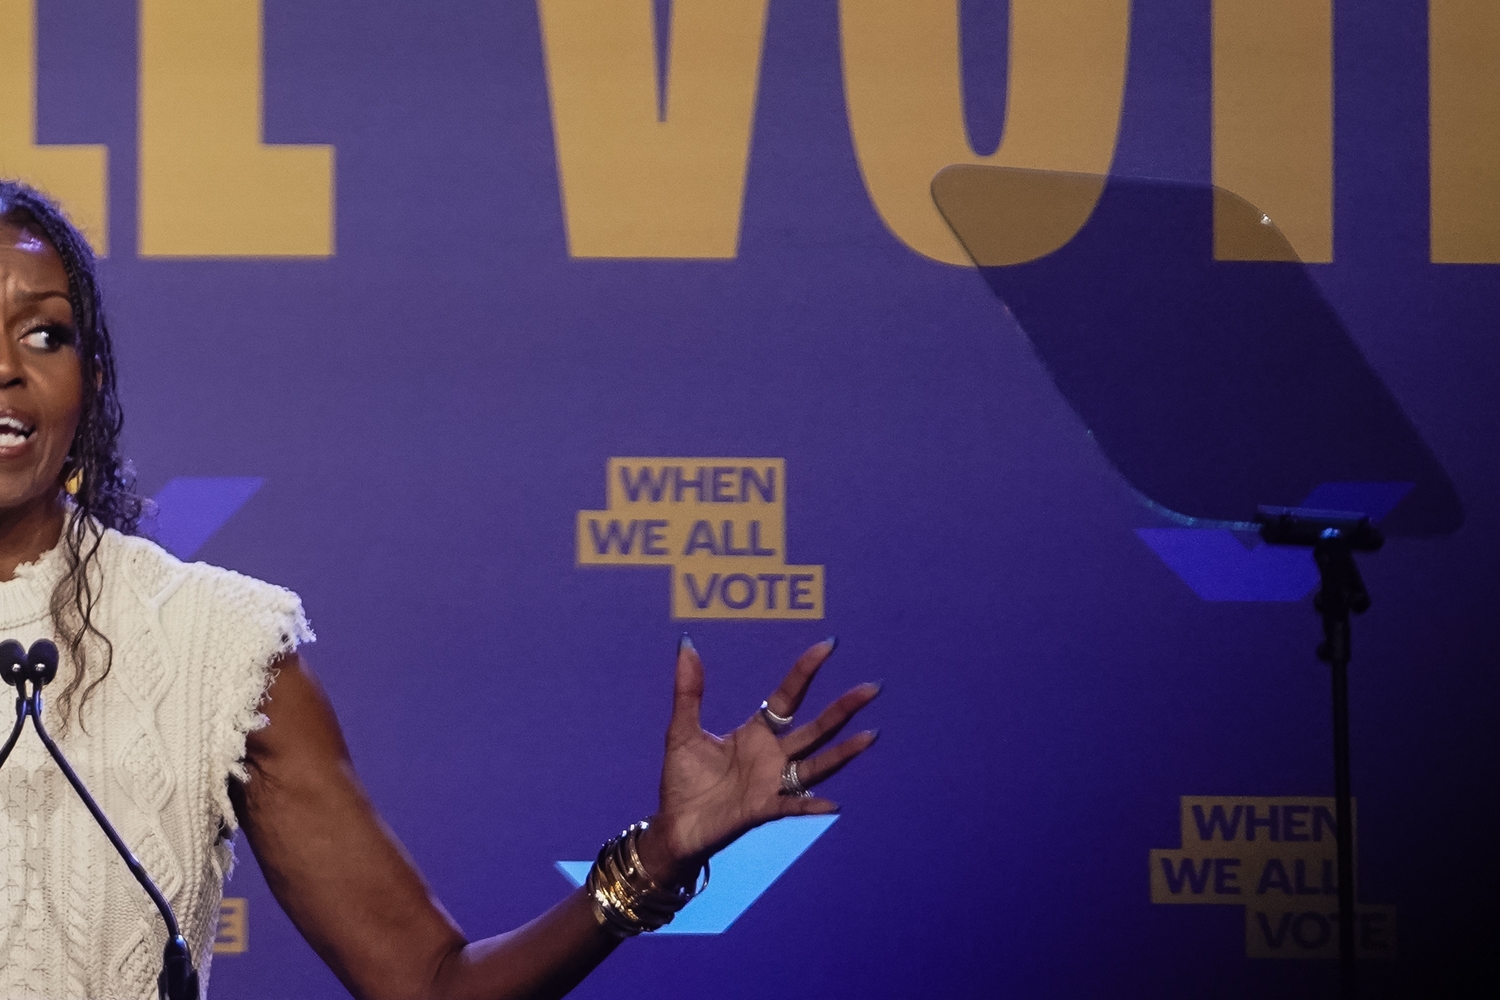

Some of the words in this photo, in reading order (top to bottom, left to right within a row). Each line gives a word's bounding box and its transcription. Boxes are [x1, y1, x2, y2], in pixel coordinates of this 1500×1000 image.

[618, 466, 777, 503] WHEN
[587, 518, 669, 556] WE
[681, 519, 777, 557] ALL
[683, 572, 816, 611] VOTE
[1160, 857, 1242, 895] WE
[1256, 911, 1389, 951] VOE
